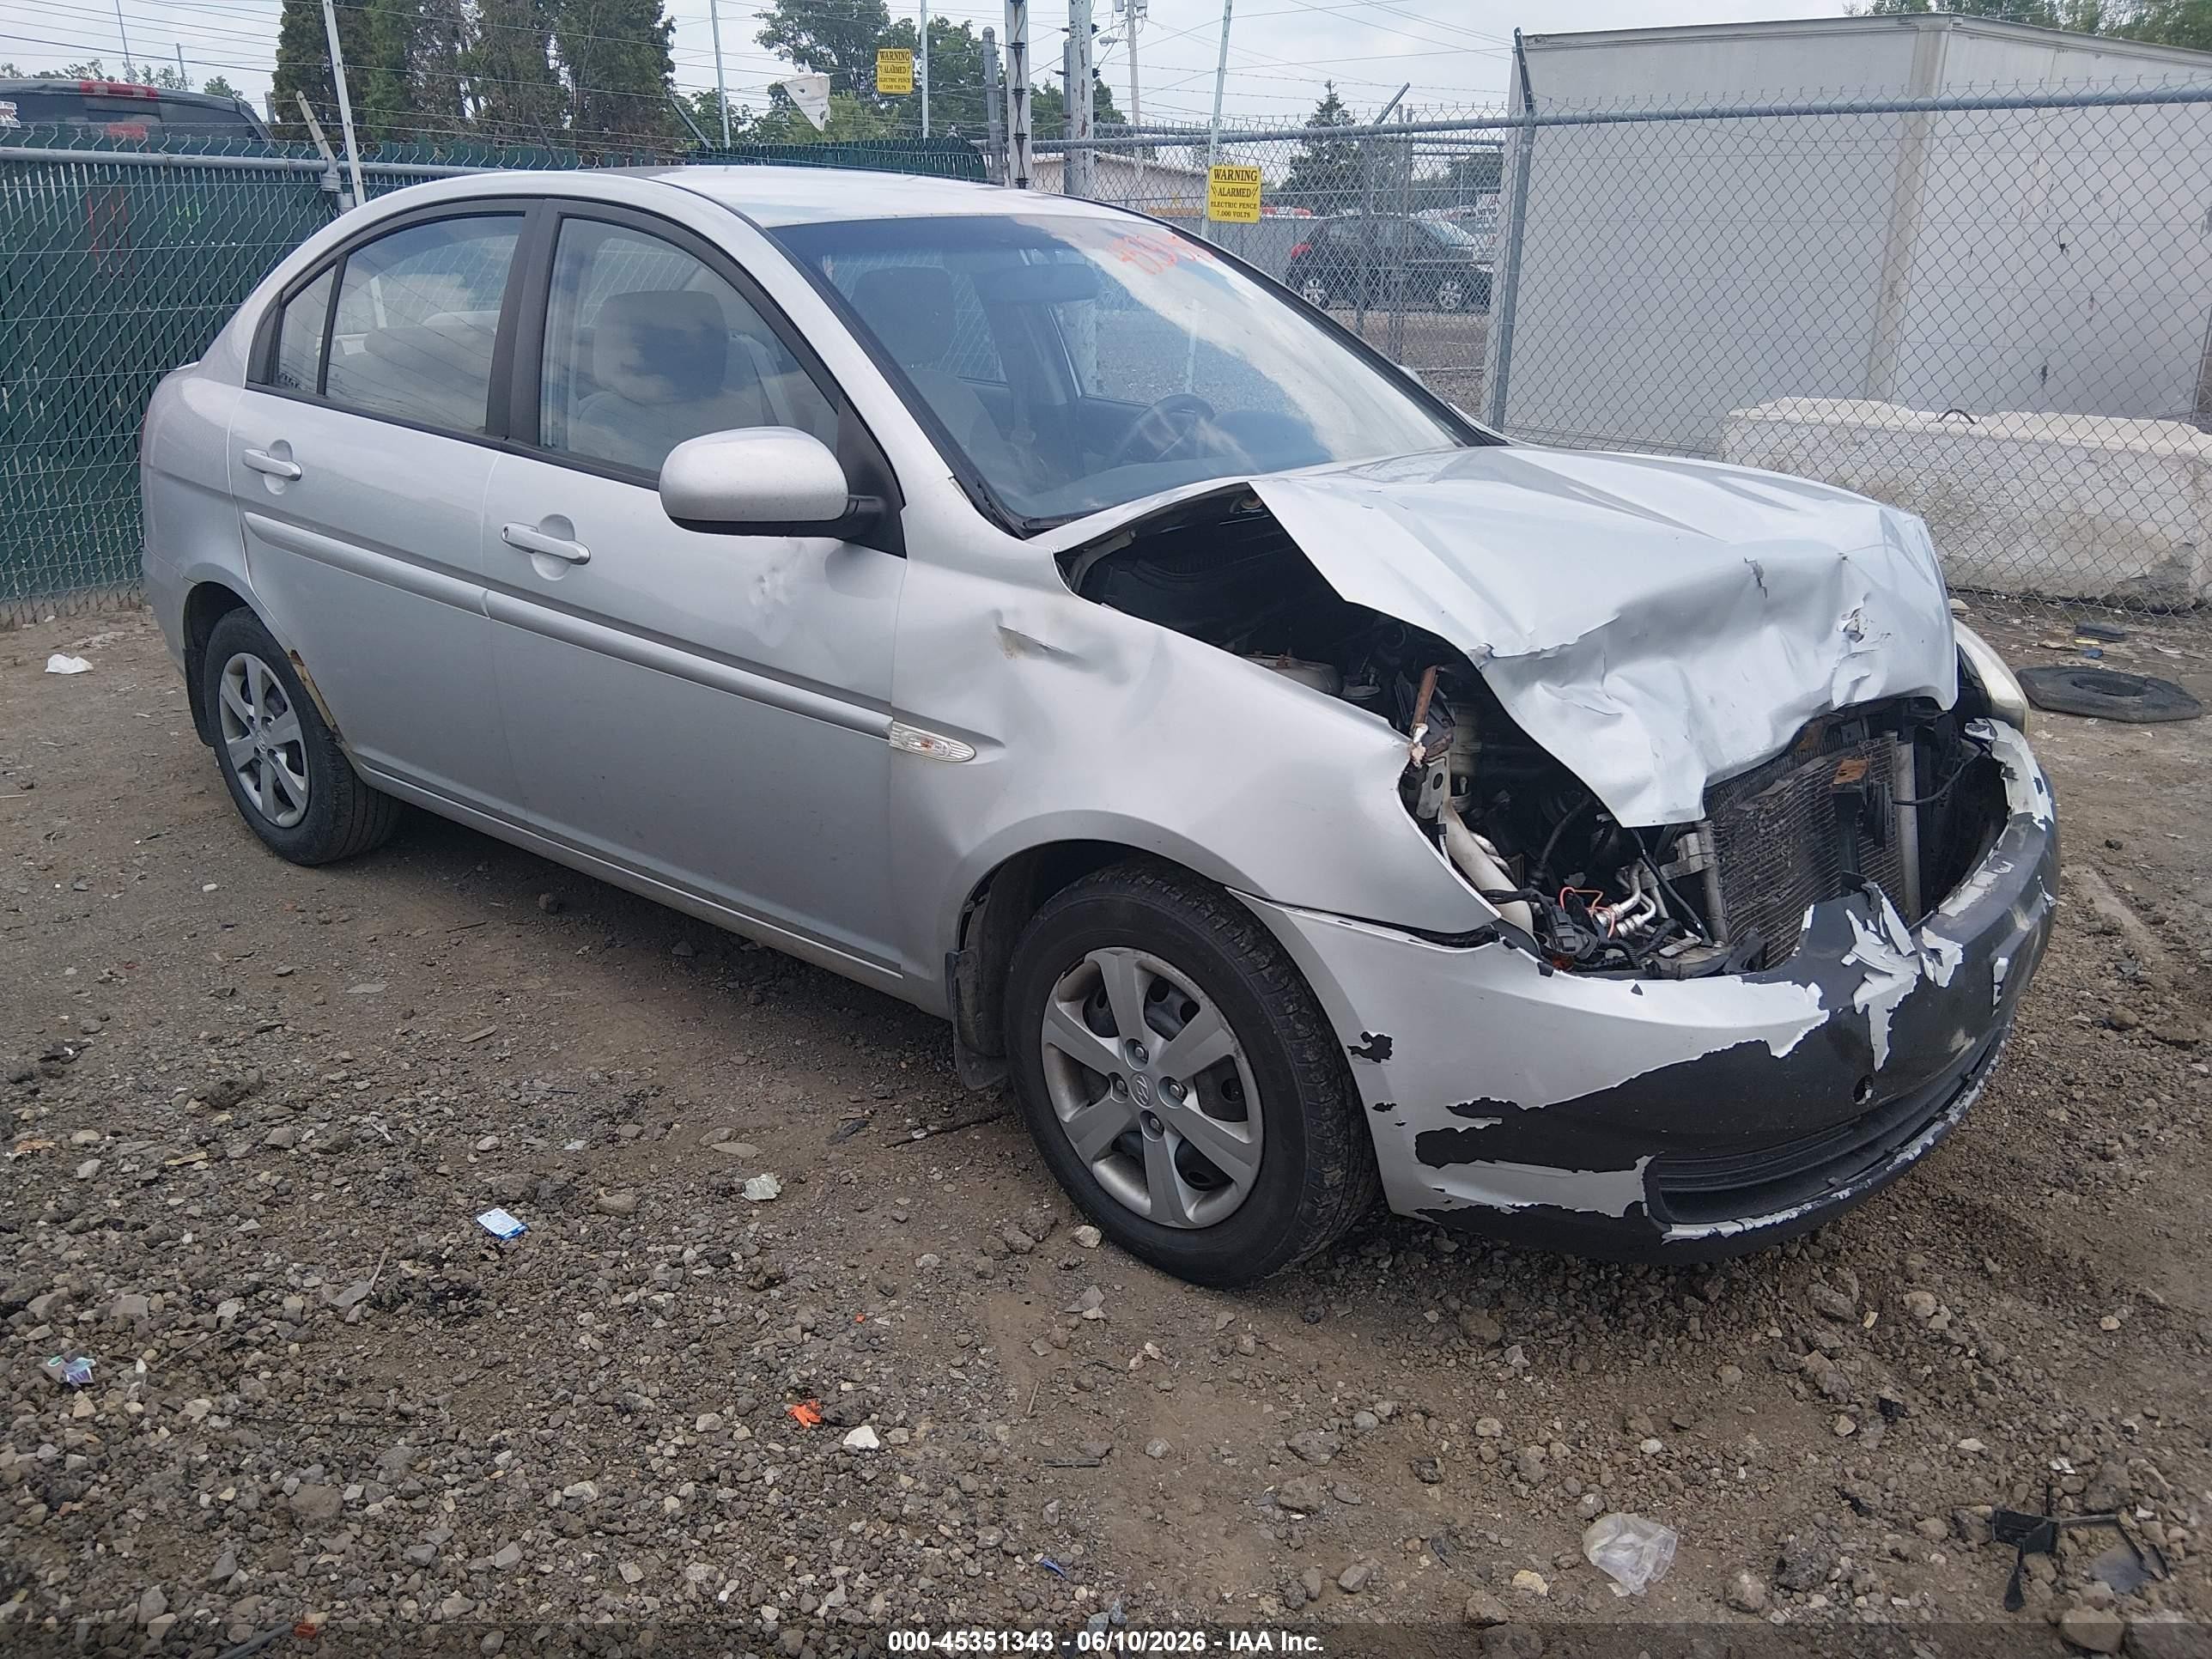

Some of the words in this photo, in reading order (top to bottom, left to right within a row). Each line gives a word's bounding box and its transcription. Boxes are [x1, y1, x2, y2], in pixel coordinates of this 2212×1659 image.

[879, 52, 909, 60] WARNING
[1214, 169, 1257, 181] WARNING
[1218, 187, 1251, 198] ALARMED
